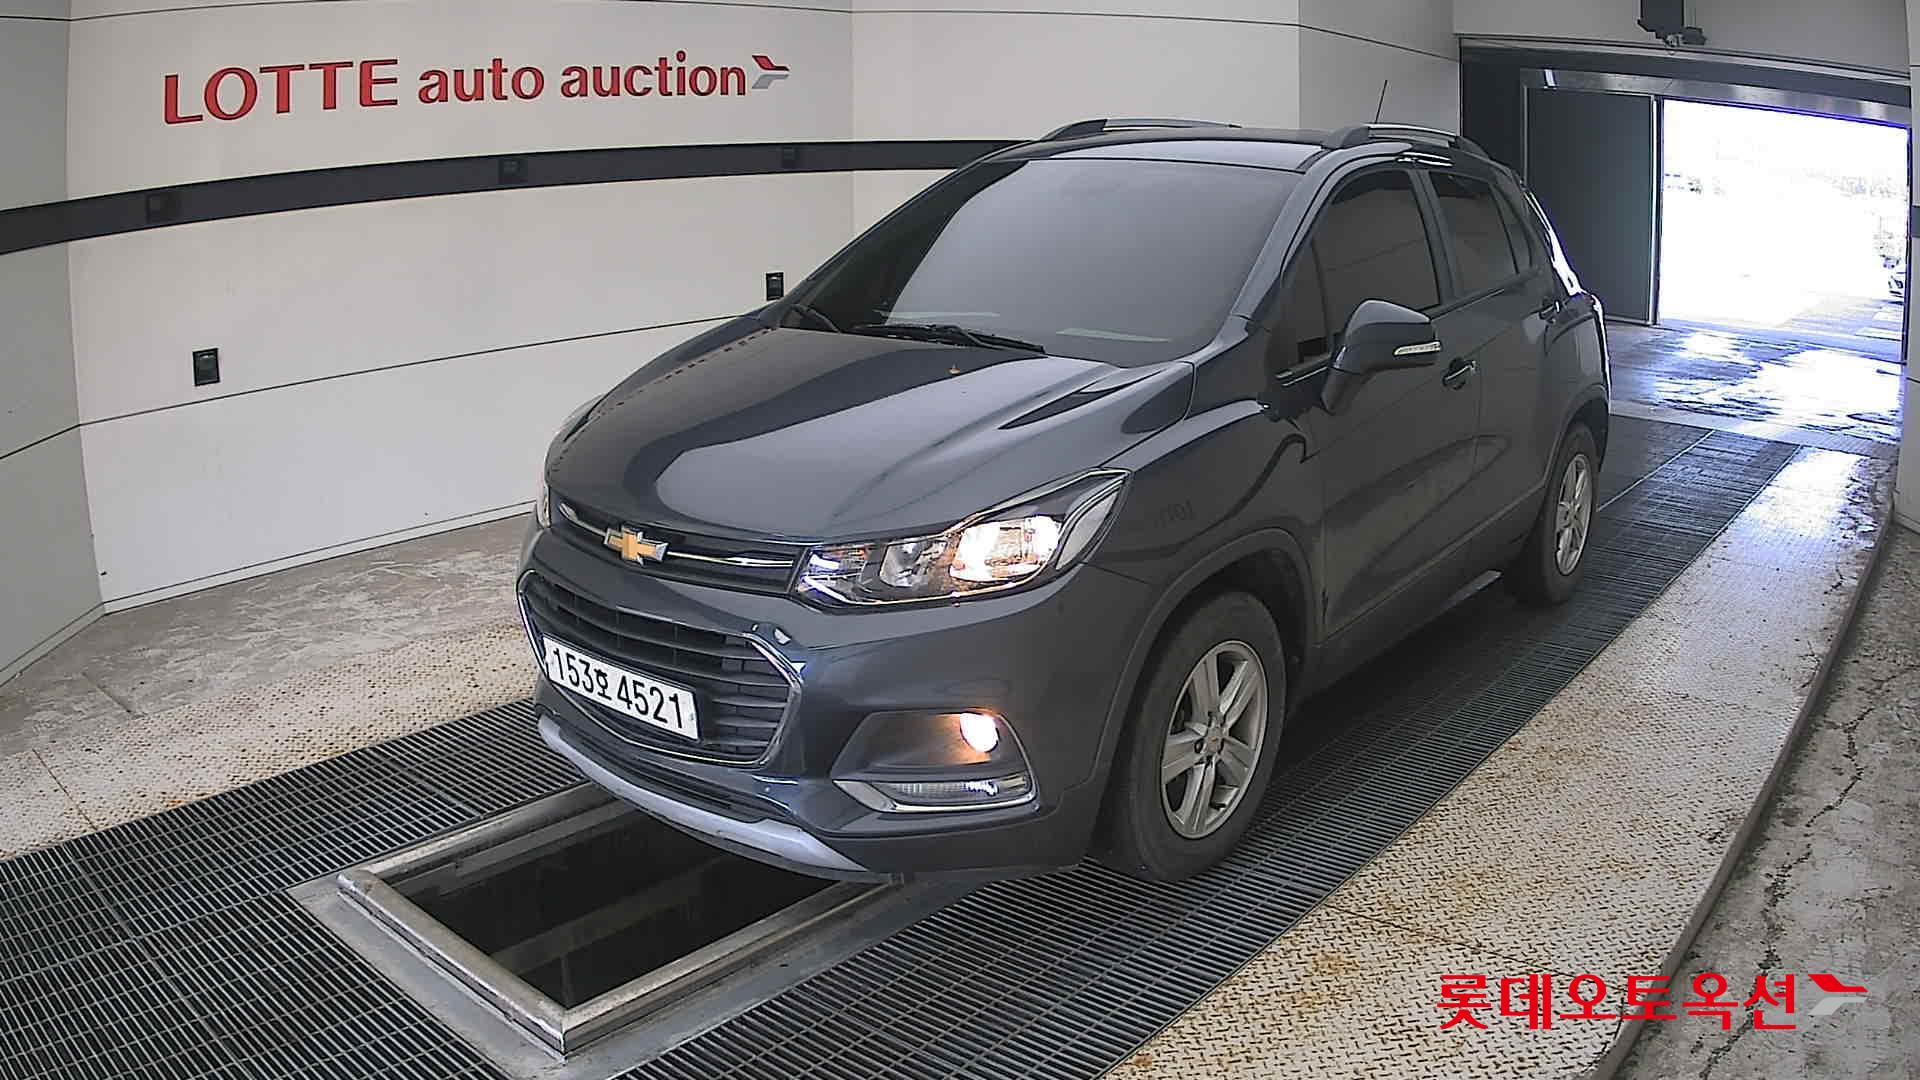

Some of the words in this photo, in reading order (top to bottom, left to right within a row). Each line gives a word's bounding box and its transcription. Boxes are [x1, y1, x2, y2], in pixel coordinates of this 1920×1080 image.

[164, 58, 398, 125] LOTTE
[418, 58, 545, 104] auto
[561, 50, 746, 97] auction
[617, 675, 683, 729] 4521
